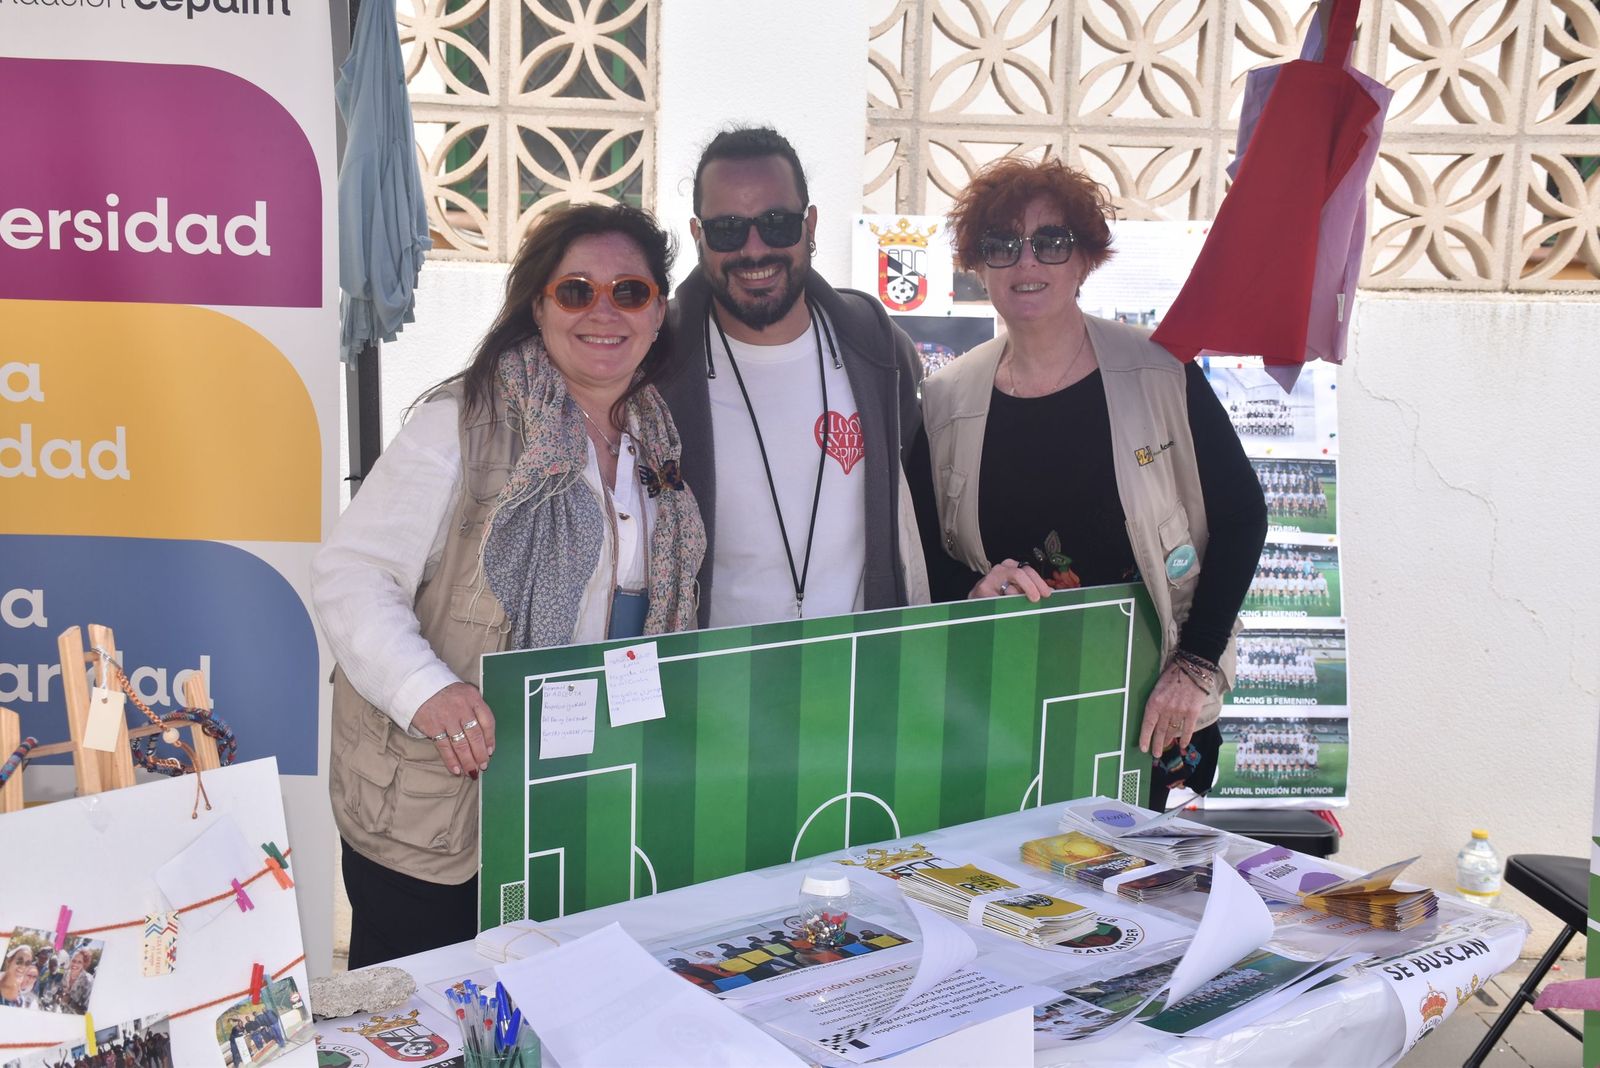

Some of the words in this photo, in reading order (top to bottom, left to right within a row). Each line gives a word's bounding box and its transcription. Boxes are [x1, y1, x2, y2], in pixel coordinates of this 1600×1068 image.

[1233, 697, 1264, 705] RACING
[1266, 697, 1273, 705] B
[1273, 697, 1318, 706] FEMENINO
[1220, 787, 1253, 795] JUVENIL
[1255, 785, 1290, 795] DIVISIÓN
[1291, 787, 1302, 795] DE
[1303, 787, 1334, 795] HONOR
[1073, 928, 1139, 954] SANTANDER
[1383, 962, 1415, 982] SE
[1408, 938, 1491, 973] BUSCAN
[785, 981, 850, 1003] FUNDACIÓN
[849, 976, 866, 987] AD
[865, 968, 900, 980] CEUTA
[899, 964, 913, 975] FC
